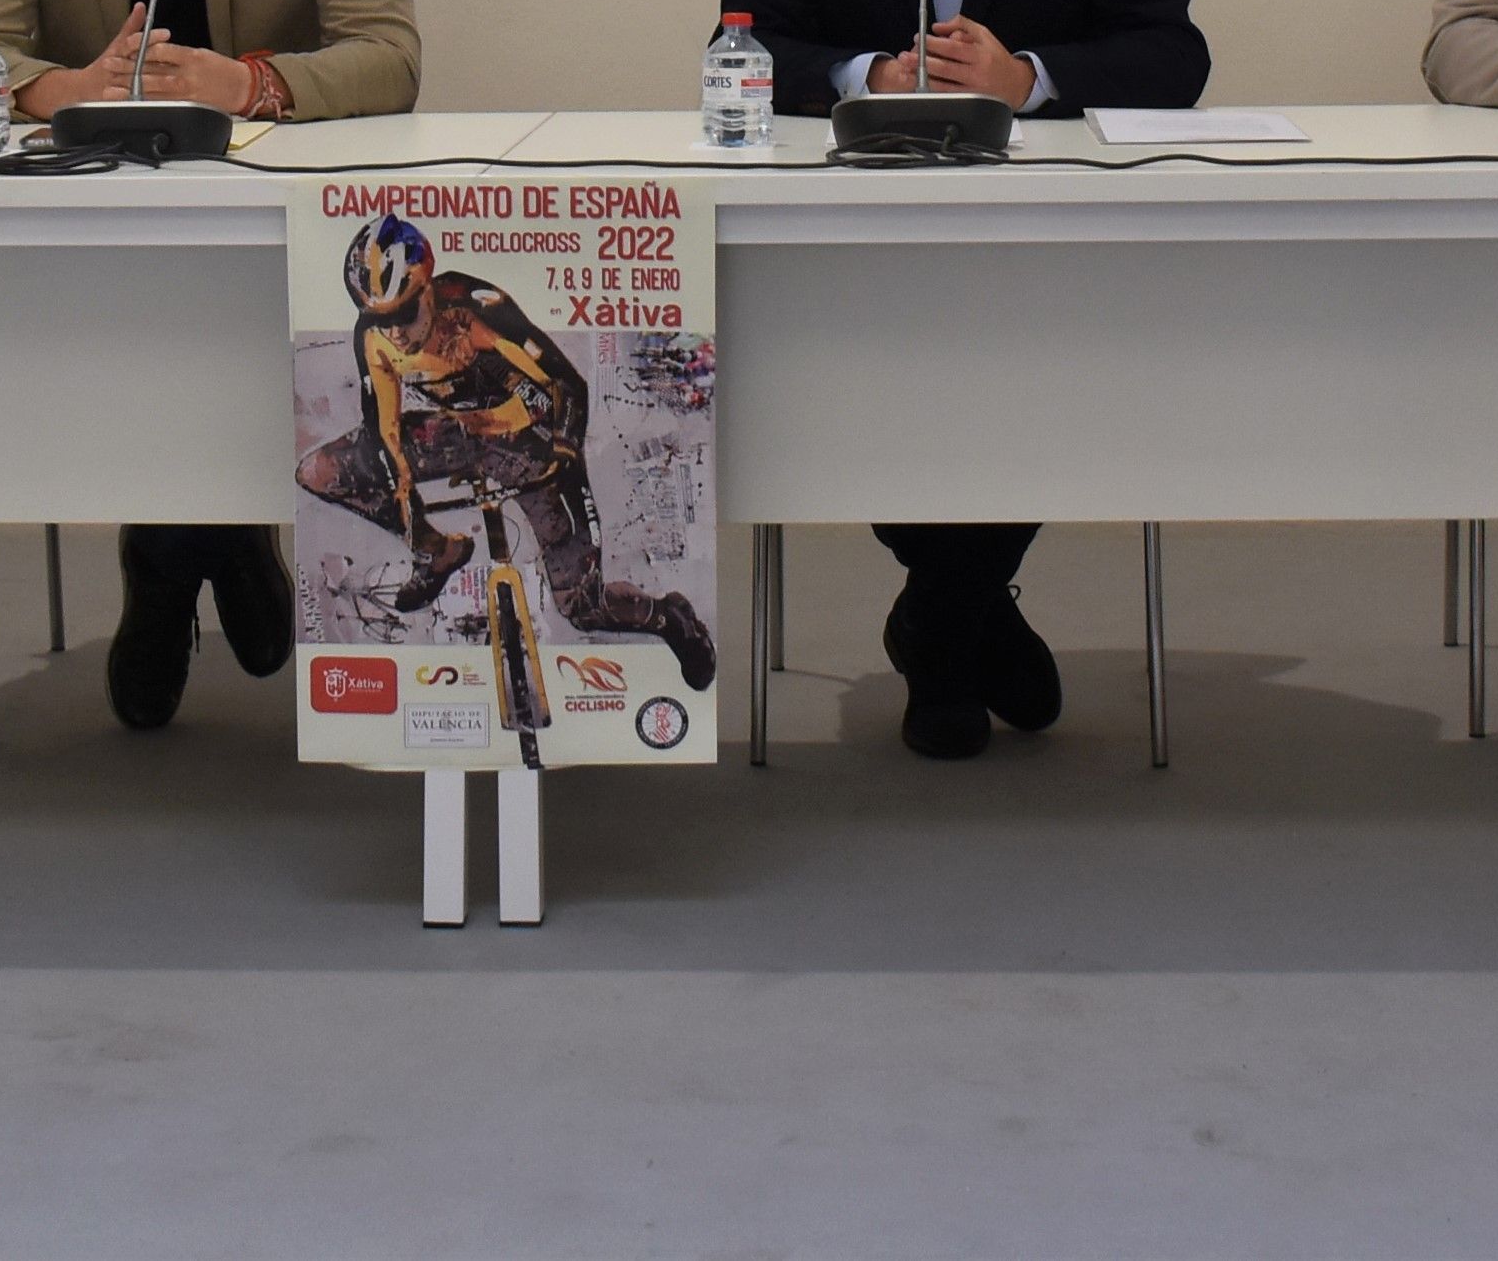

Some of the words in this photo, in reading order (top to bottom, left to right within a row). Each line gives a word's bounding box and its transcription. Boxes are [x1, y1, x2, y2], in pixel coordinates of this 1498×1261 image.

[704, 75, 733, 89] CORTES
[322, 184, 512, 218] CAMPEONATO
[523, 185, 561, 219] DE
[569, 181, 681, 219] ESPAÑA
[441, 232, 466, 253] DE
[471, 232, 581, 254] CICLOCROSS
[597, 225, 675, 262] 2022
[602, 267, 621, 290] DE
[632, 267, 681, 292] ENERO
[567, 295, 683, 327] Xàtiva
[564, 700, 626, 712] CICLISMO
